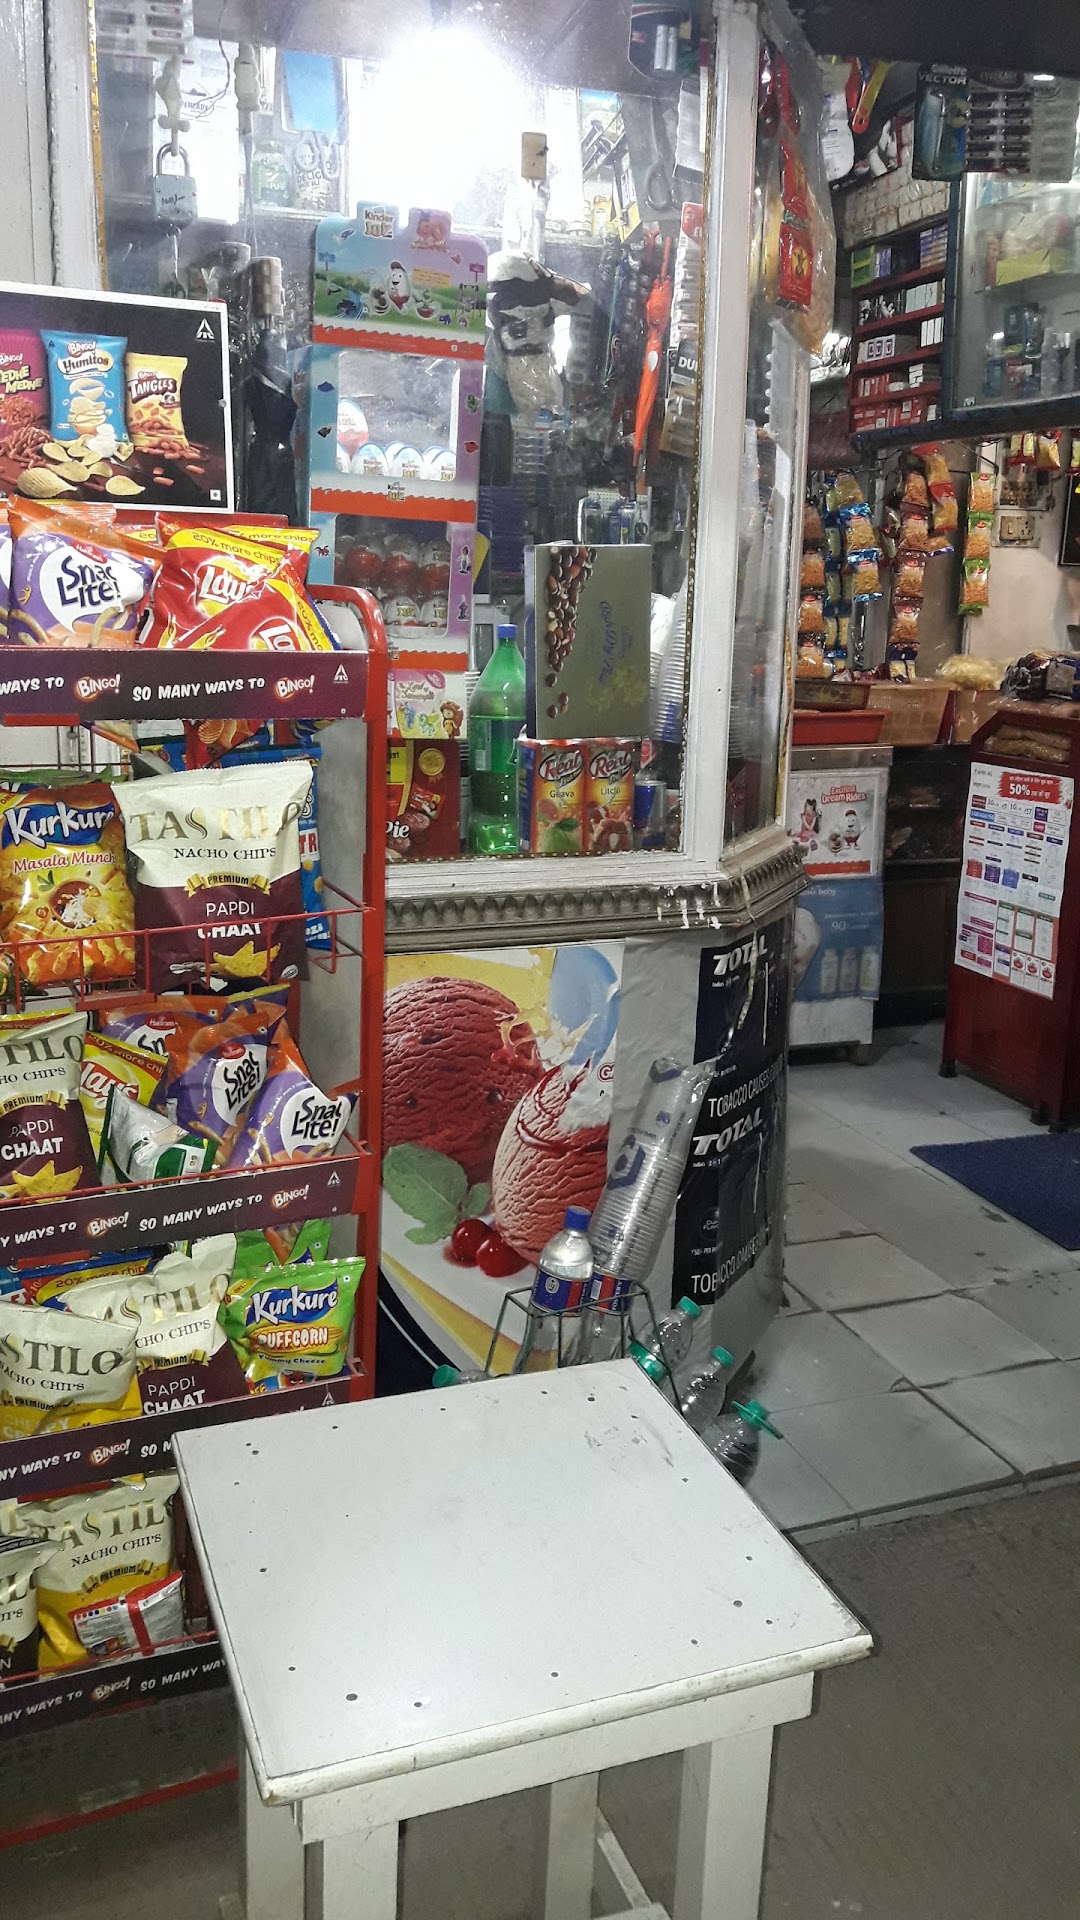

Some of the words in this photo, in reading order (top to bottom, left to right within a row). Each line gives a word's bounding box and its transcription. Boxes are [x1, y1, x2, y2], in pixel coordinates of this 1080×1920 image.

[918, 72, 967, 86] VECTOR
[931, 63, 967, 76] Gillette
[62, 354, 109, 373] Yumitos
[129, 379, 175, 397] TANGLES
[192, 531, 220, 548] 20%
[221, 543, 251, 557] more
[253, 550, 281, 566] chips
[60, 555, 118, 591] Snac
[56, 576, 121, 608] Lite!
[0, 678, 40, 696] WAYS
[45, 677, 64, 689] TO
[76, 674, 121, 699] BINGO!
[132, 686, 152, 702] SO
[157, 683, 201, 701] MANY
[205, 677, 244, 694] WAYS
[249, 677, 266, 690] TO
[276, 674, 316, 698] BINGO!
[544, 753, 580, 780] Real
[594, 751, 628, 777] Real
[821, 793, 845, 804] Dream
[845, 791, 867, 803] Rides
[1009, 783, 1031, 796] 50%
[129, 802, 302, 843] TASTILO
[14, 852, 69, 874] Masala
[71, 850, 116, 865] Munch
[173, 848, 228, 860] NACHO
[233, 846, 277, 860] CHIPS
[207, 873, 250, 886] PREMIUM
[205, 901, 255, 917] PAPDI
[197, 921, 262, 940] CHAAT
[831, 920, 847, 932] 90
[713, 934, 769, 976] TOTAL
[23, 1067, 66, 1081] CHIPS
[223, 1050, 260, 1088] Snac
[224, 1068, 261, 1111] Lite!
[707, 1083, 748, 1119] TOBACCO
[3, 1094, 44, 1112] PREMIUM
[300, 1095, 342, 1121] Snac
[10, 1118, 55, 1138] PAPDI
[290, 1110, 340, 1141] Lite!
[692, 1106, 763, 1157] TOTAL
[1, 1136, 65, 1160] CHAAT
[14, 1225, 55, 1245] WAYS
[59, 1222, 77, 1234] TO
[87, 1211, 130, 1237] BINGO!
[138, 1217, 157, 1232] SO
[163, 1208, 203, 1227] MANY
[206, 1198, 243, 1216] WAYS
[246, 1193, 263, 1204] TO
[271, 1184, 310, 1209] BINGO!
[56, 1273, 83, 1288] 20%
[691, 1255, 736, 1295] TOBACCO
[168, 1318, 212, 1340] CHIPS
[256, 1327, 328, 1350] PUFFCORN
[153, 1355, 188, 1368] PREMIUM
[258, 1353, 291, 1365] Yummy
[293, 1358, 326, 1366] Cheese
[40, 1379, 86, 1392] CHIPS
[147, 1375, 197, 1398] PAPDI
[143, 1389, 207, 1416] CHAAT
[21, 1454, 61, 1475] WAYS
[63, 1450, 81, 1463] TO
[90, 1438, 131, 1465] BINGO!
[140, 1443, 158, 1458] SO
[71, 1545, 118, 1568] NACHO
[122, 1533, 162, 1552] CHIPS
[100, 1564, 136, 1582] PREMIUM
[26, 1696, 62, 1715] WAYS
[67, 1690, 83, 1702] TO
[91, 1676, 131, 1702] BINGO!
[140, 1678, 156, 1692] SO
[161, 1667, 199, 1686] MANY
